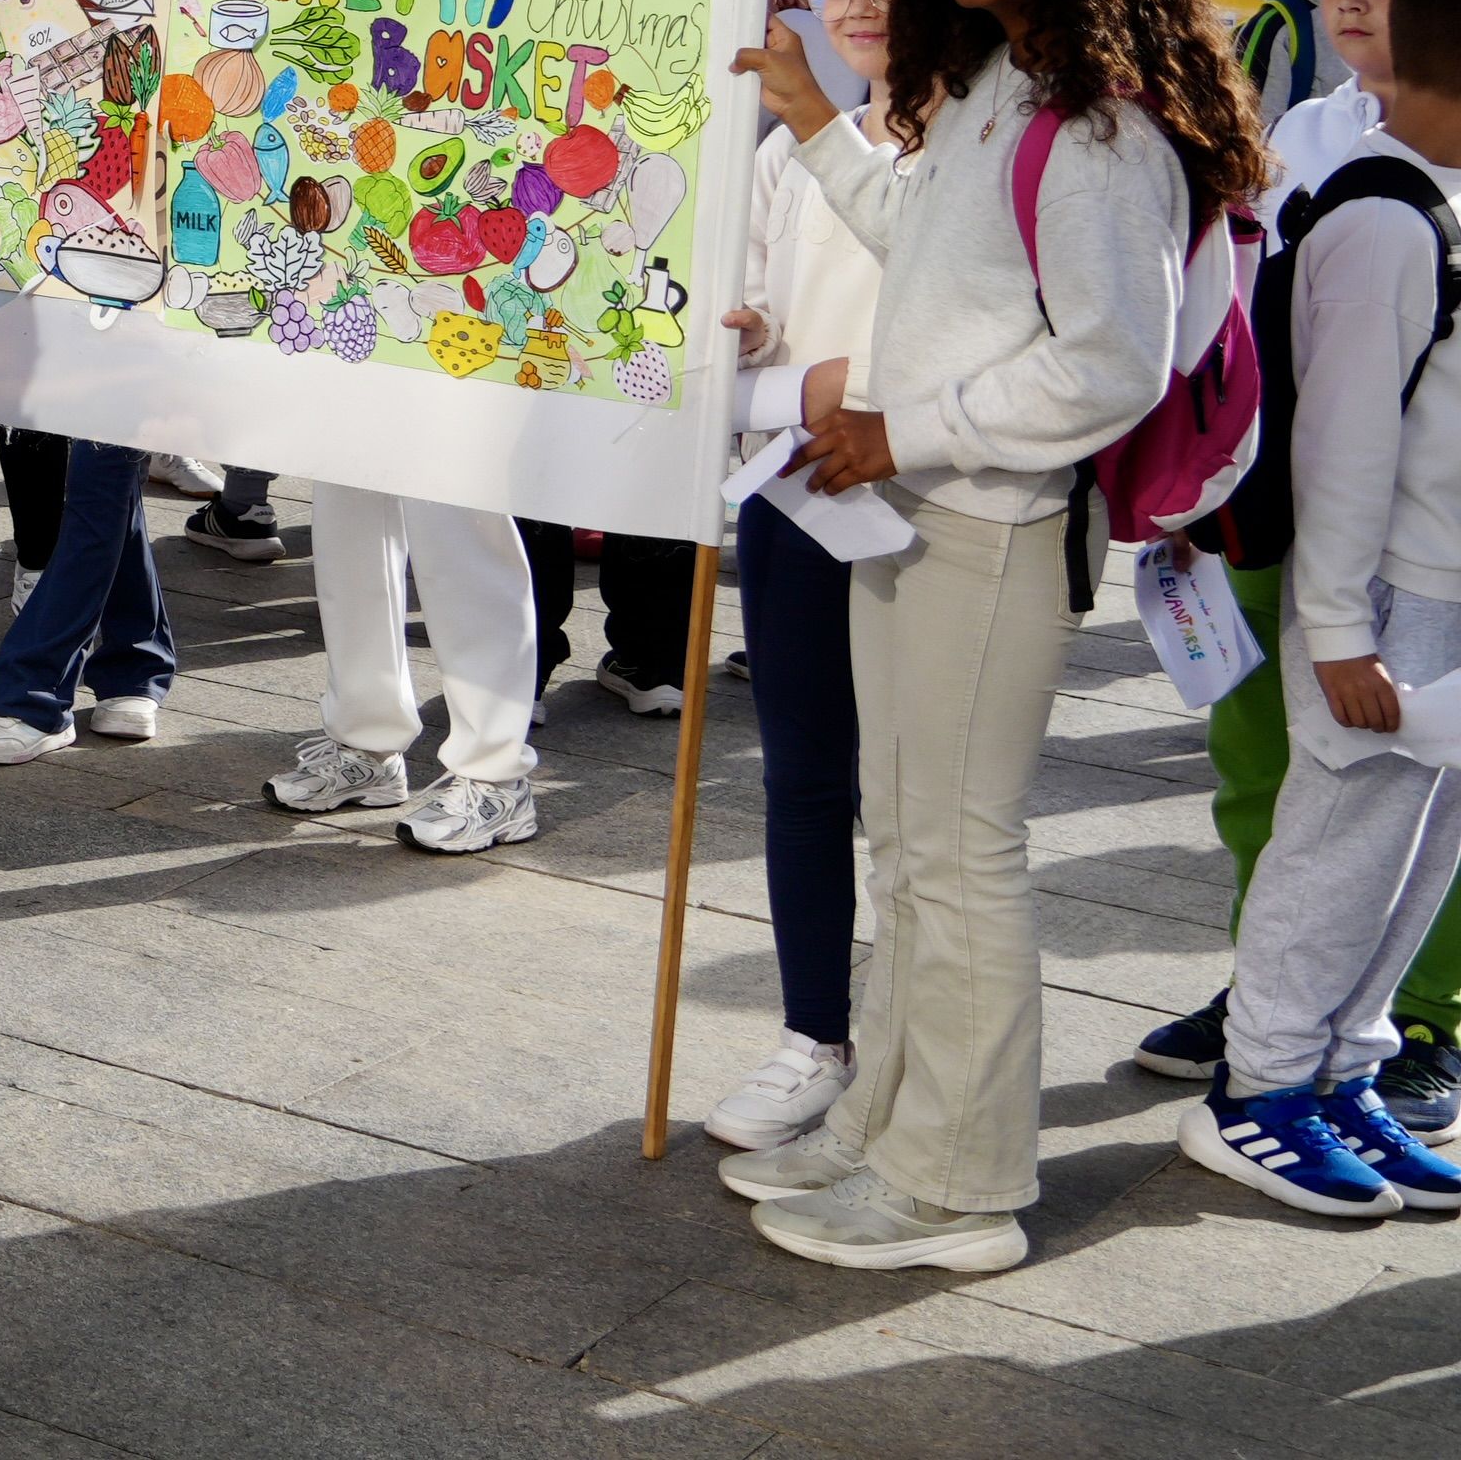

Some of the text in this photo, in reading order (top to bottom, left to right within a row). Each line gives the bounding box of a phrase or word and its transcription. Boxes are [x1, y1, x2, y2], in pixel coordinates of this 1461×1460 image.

[29, 27, 53, 47] 80%
[176, 212, 217, 233] MILK
[1157, 564, 1205, 661] LEVANTARSE
